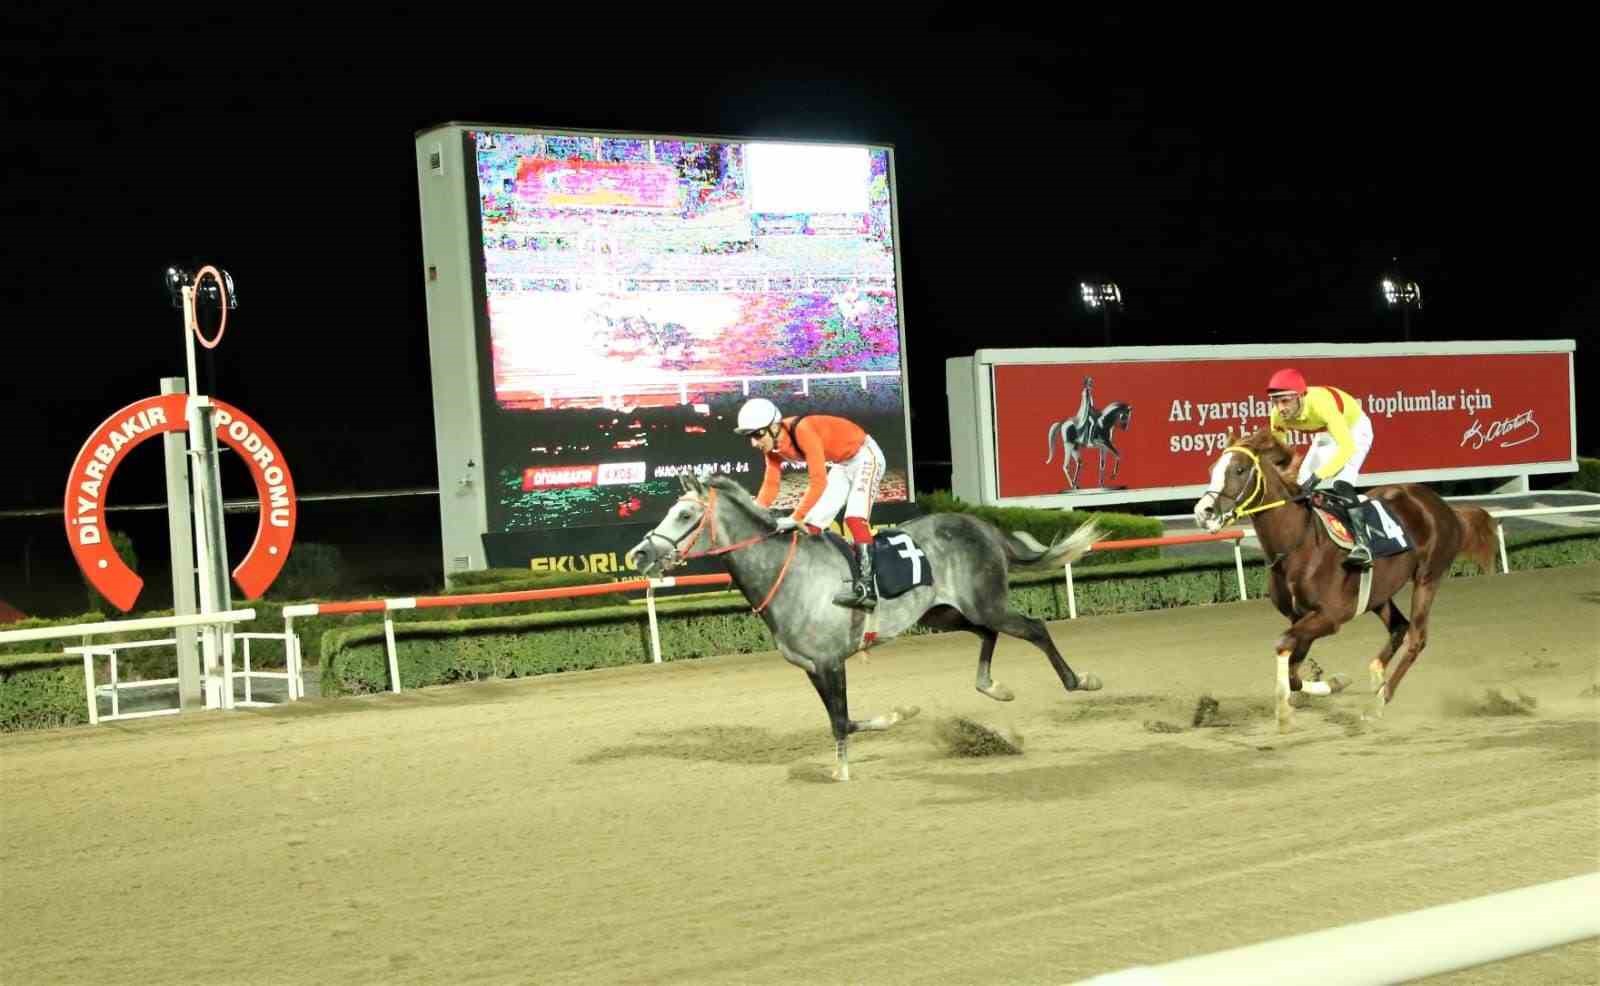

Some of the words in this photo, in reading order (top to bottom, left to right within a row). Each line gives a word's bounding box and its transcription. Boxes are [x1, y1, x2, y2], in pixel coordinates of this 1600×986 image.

[1168, 399, 1192, 422] At
[1368, 389, 1456, 418] toplumlar
[1460, 388, 1492, 416] için
[72, 406, 168, 545] DİYARBAKIR
[185, 401, 290, 528] PODROMU
[1365, 499, 1408, 548] 4
[886, 533, 925, 585] 7
